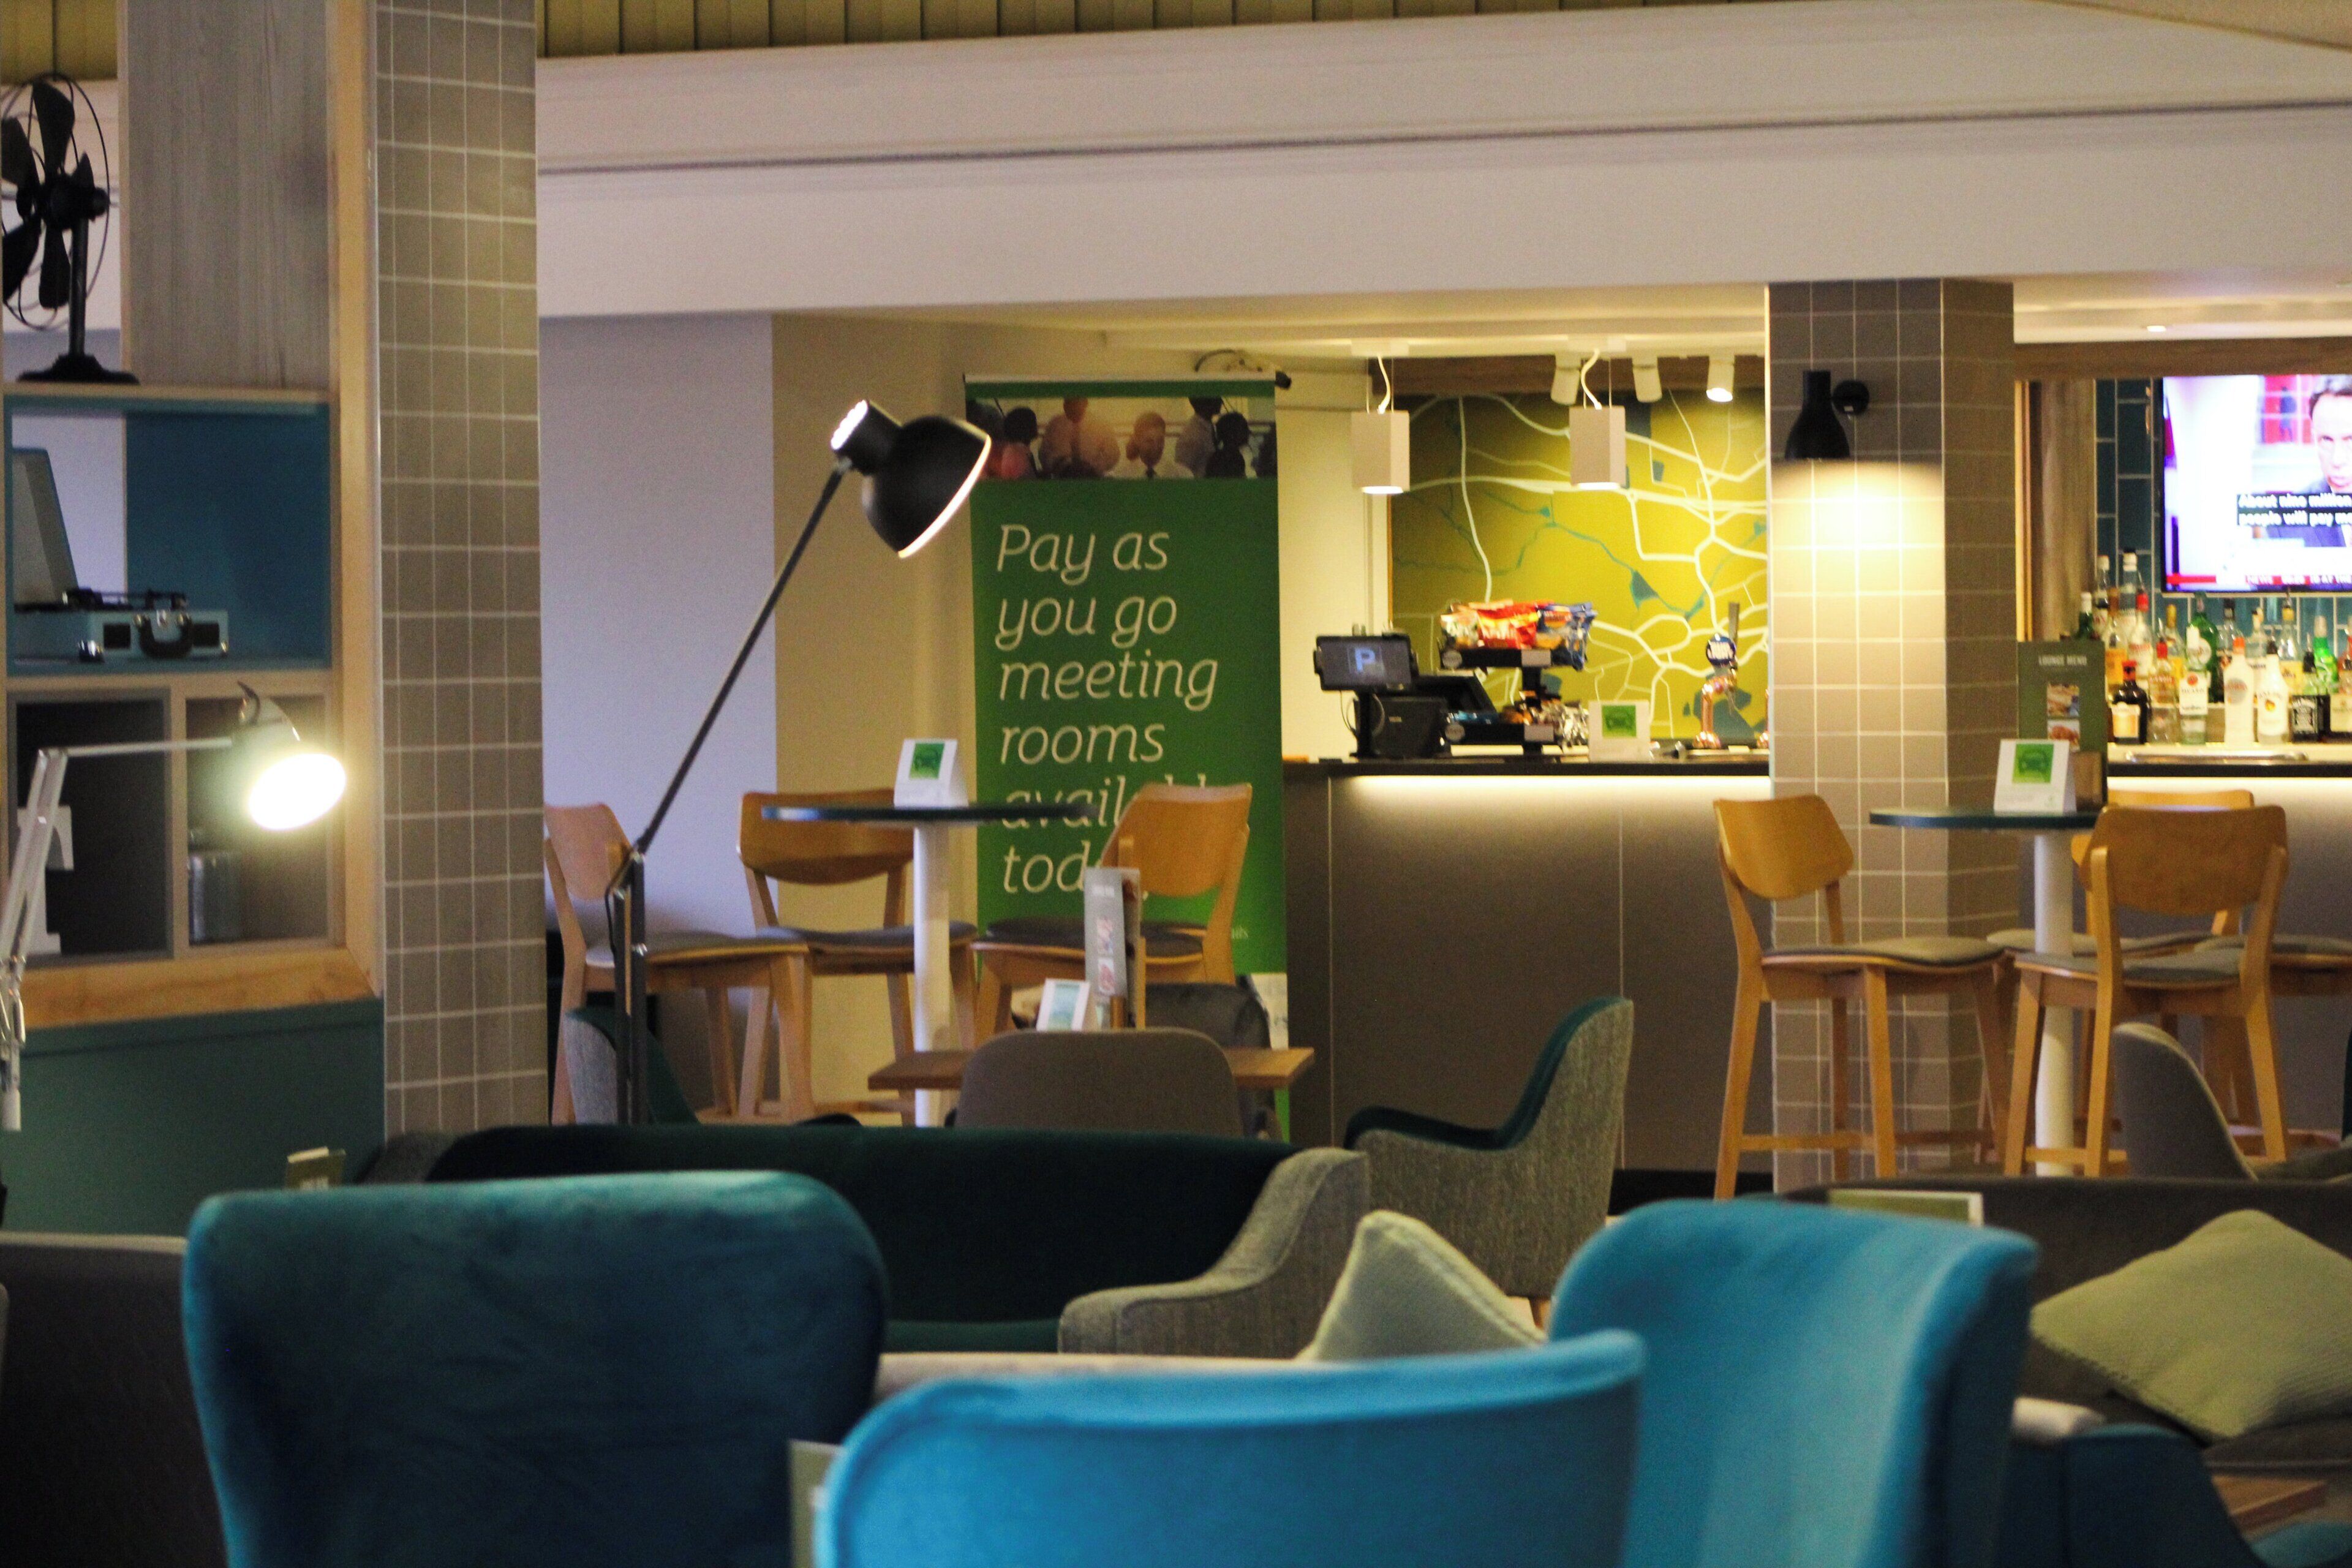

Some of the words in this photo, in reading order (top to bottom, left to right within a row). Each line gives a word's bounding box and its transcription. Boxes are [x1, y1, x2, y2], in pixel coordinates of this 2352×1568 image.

[2238, 494, 2277, 508] About
[2278, 493, 2307, 508] nine
[2239, 510, 2282, 527] people
[2282, 510, 2308, 525] will
[2309, 512, 2334, 527] pay
[997, 524, 1096, 586] Pay
[1112, 532, 1170, 571] as
[994, 597, 1097, 651] you
[1110, 595, 1178, 649] go
[999, 647, 1218, 712] meeting
[1000, 723, 1166, 765] rooms
